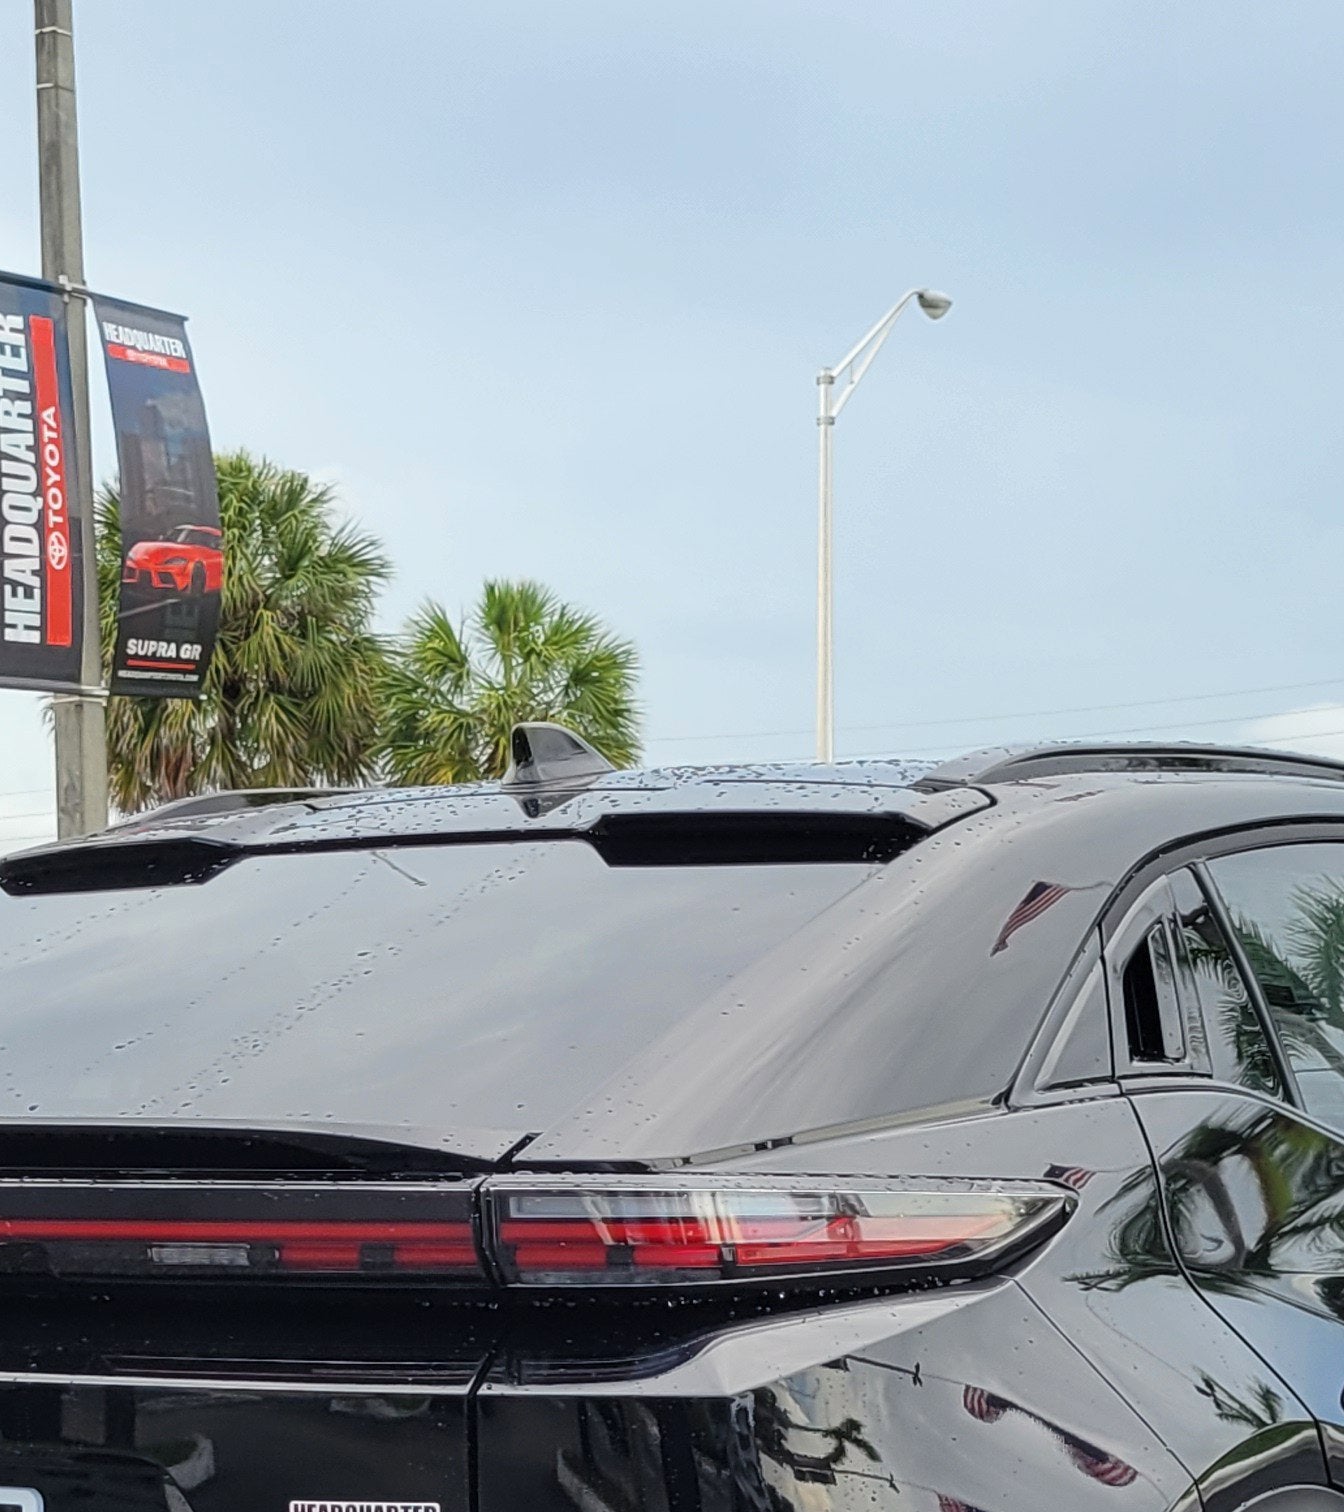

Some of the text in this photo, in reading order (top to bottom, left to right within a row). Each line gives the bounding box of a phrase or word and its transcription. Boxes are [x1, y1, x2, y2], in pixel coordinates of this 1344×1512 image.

[39, 406, 68, 528] TOYOTA
[126, 638, 202, 660] SUPRA GR
